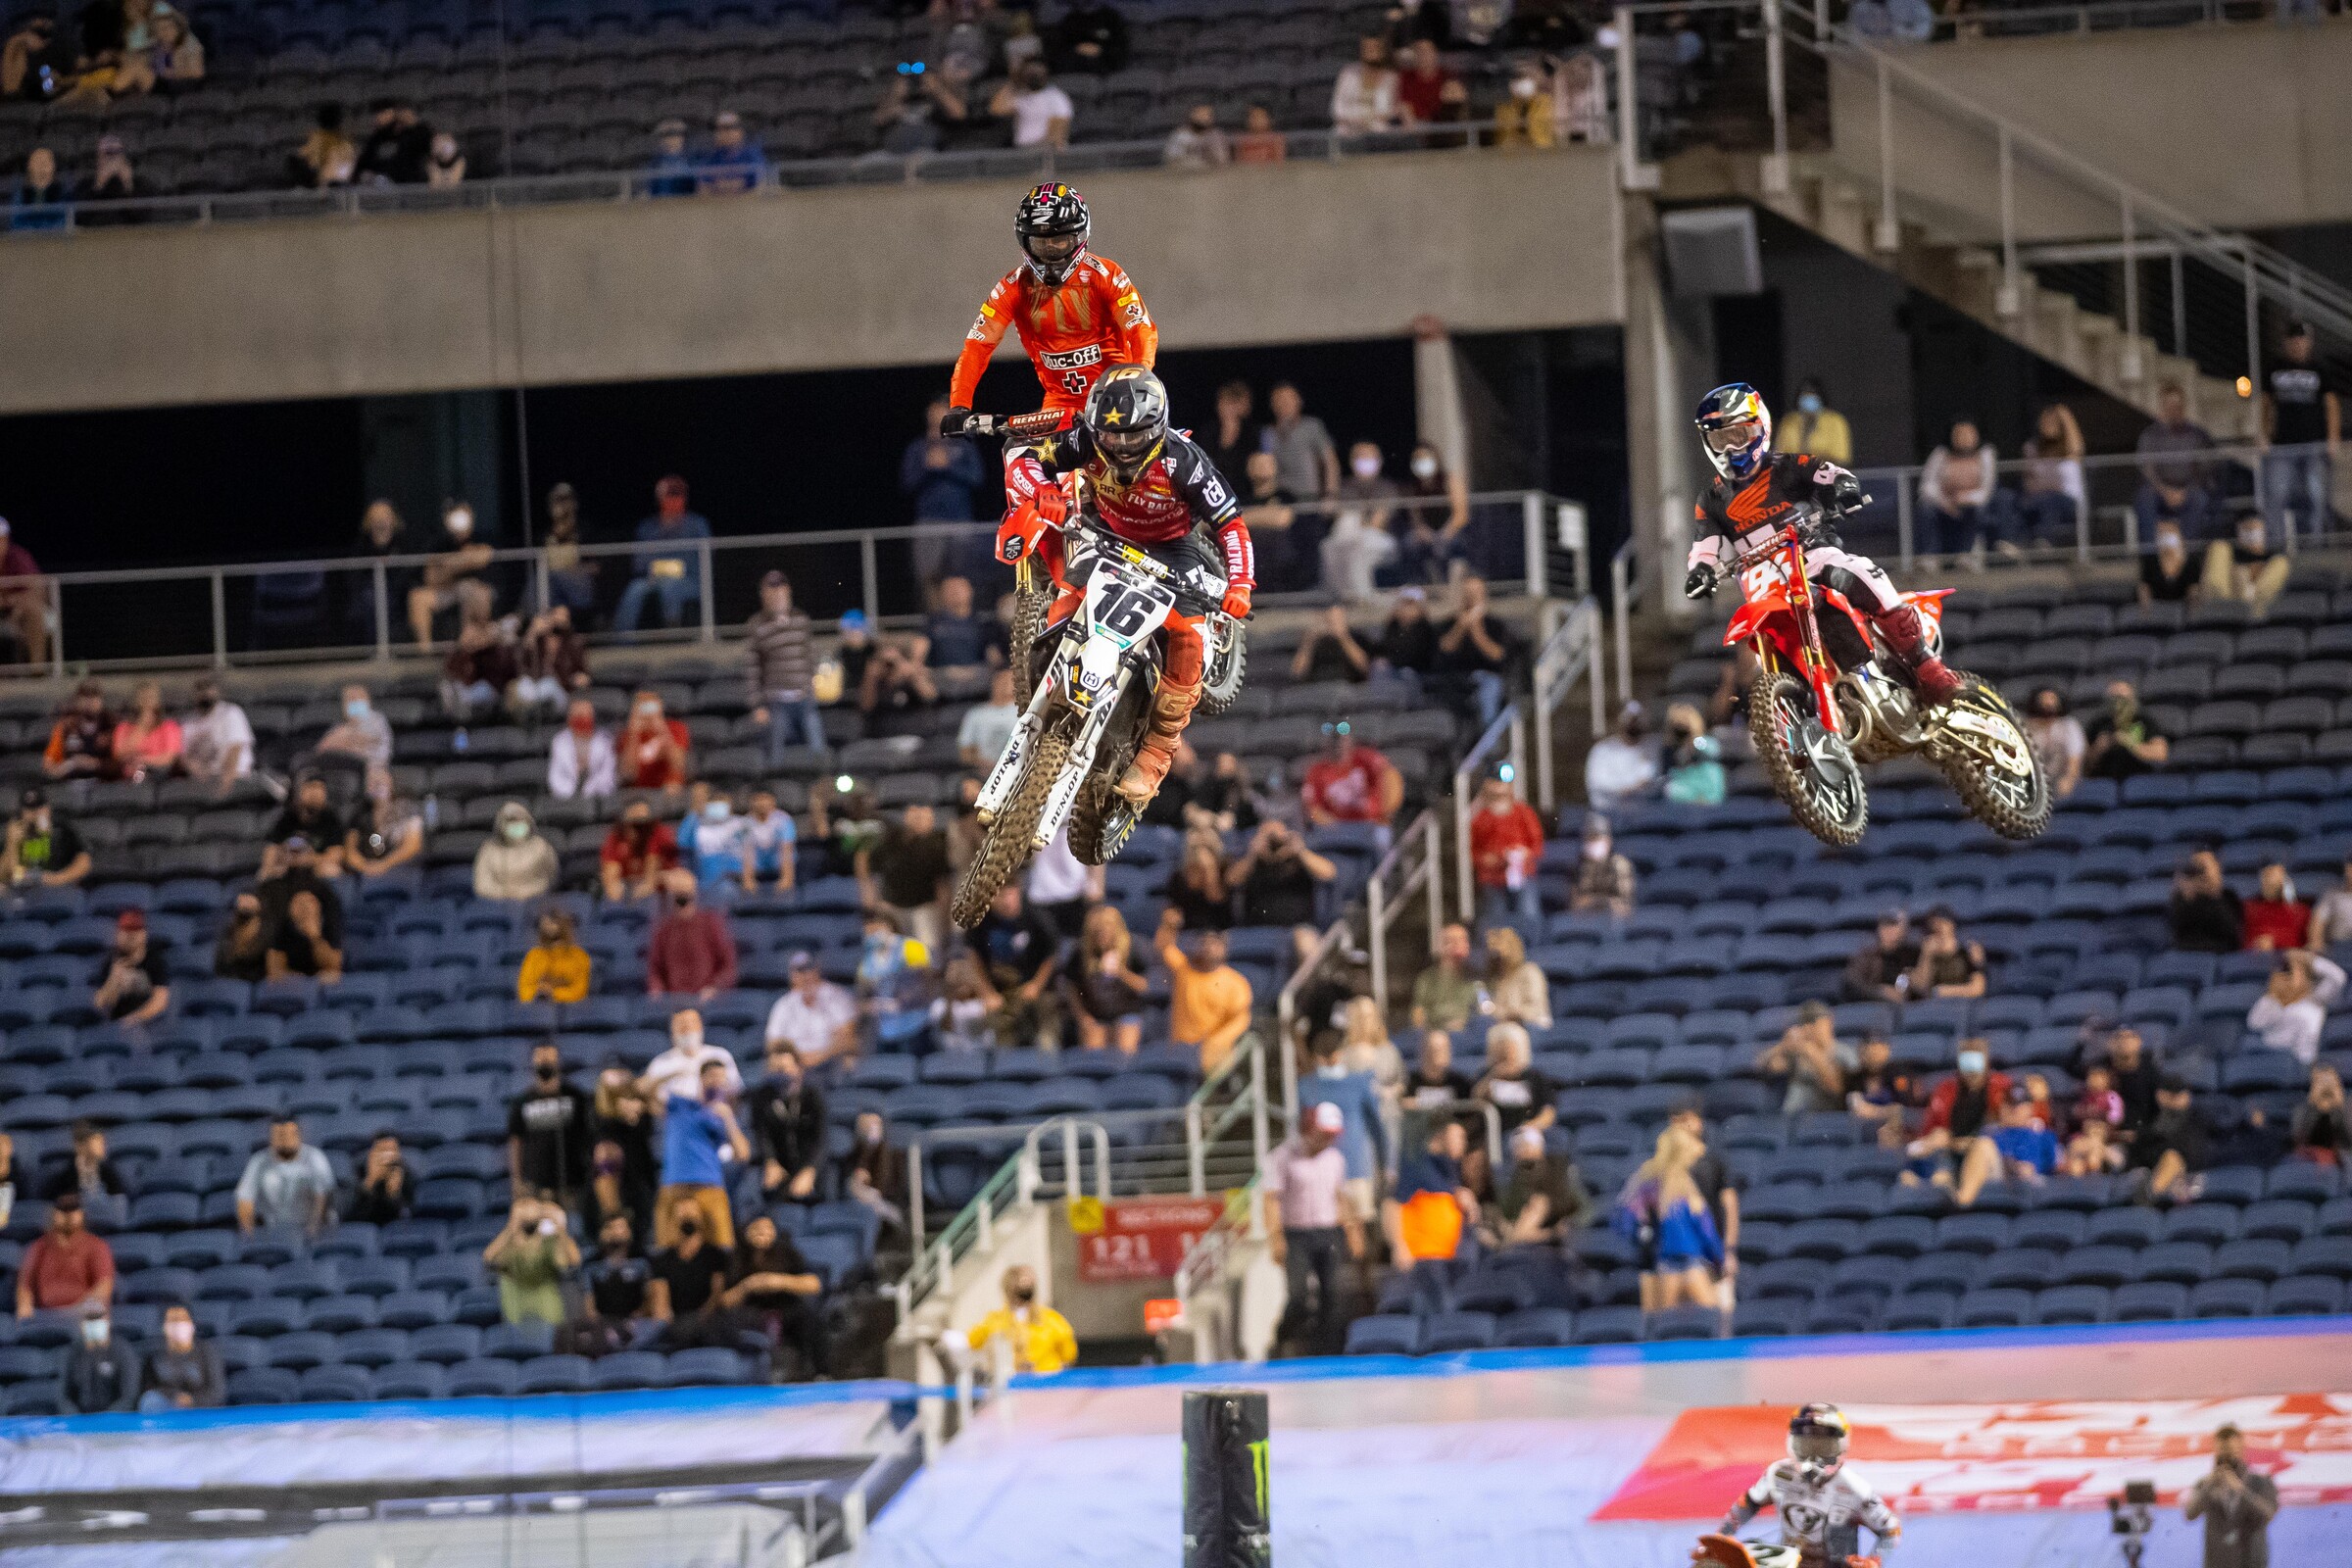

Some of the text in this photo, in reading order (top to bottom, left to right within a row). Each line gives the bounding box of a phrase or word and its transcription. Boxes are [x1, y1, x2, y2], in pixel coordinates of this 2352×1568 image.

[1044, 346, 1098, 368] Muc-Off
[1103, 368, 1145, 387] 16
[1127, 493, 1147, 507] FLY
[1147, 501, 1176, 511] RAC
[1734, 500, 1793, 533] HONDA
[1223, 530, 1244, 573] RACING
[1748, 550, 1792, 603] 94
[1094, 583, 1156, 637] 16
[990, 741, 1020, 795] DNLOP
[1050, 770, 1079, 827] DUNLOP
[1093, 1234, 1151, 1262] 121
